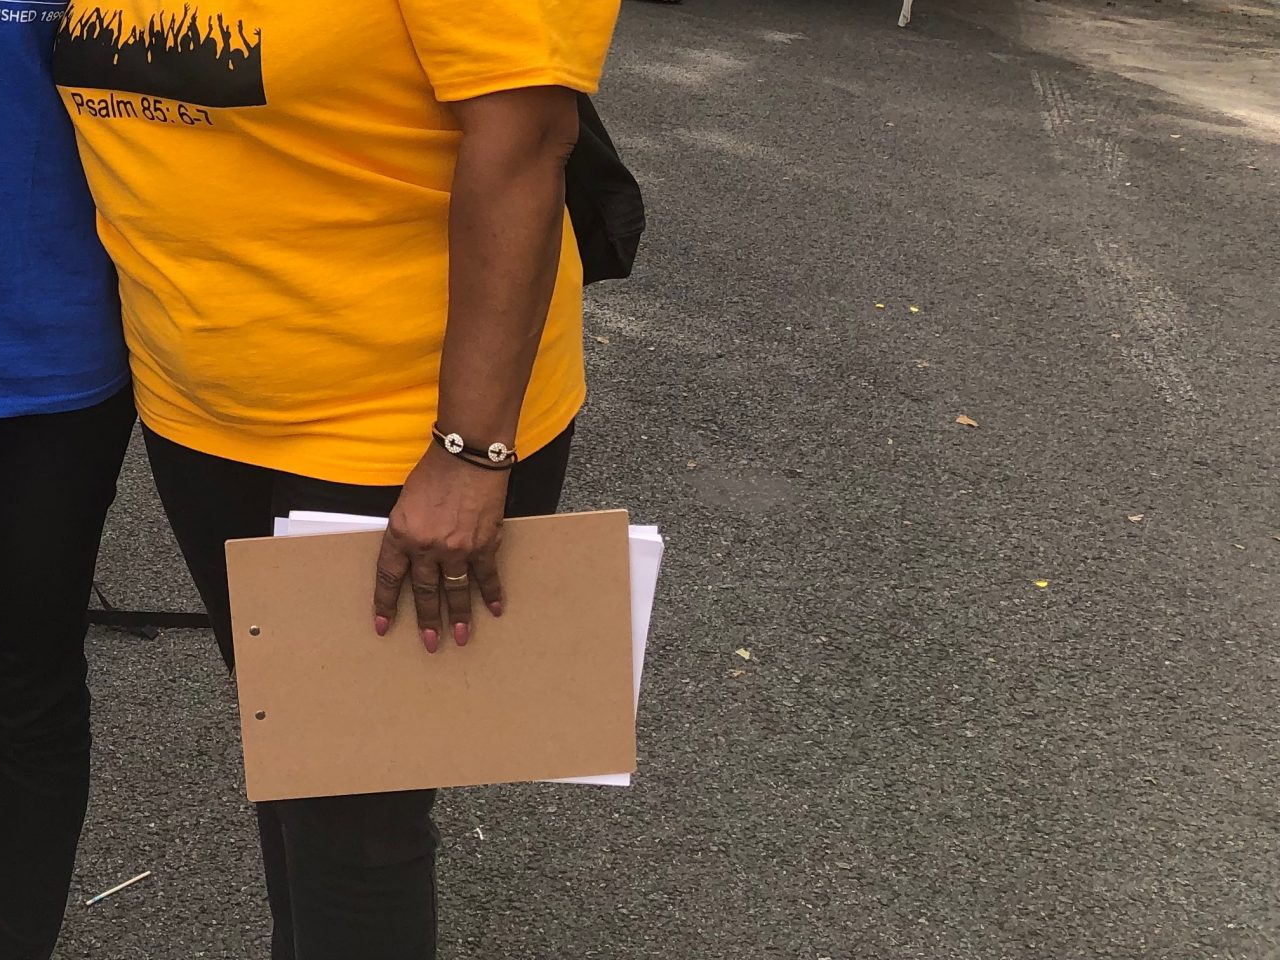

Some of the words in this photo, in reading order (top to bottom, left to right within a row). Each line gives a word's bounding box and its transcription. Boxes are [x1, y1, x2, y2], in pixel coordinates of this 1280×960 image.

[71, 92, 138, 119] Psalm
[141, 97, 176, 123] 85:
[178, 104, 213, 126] 6-7
